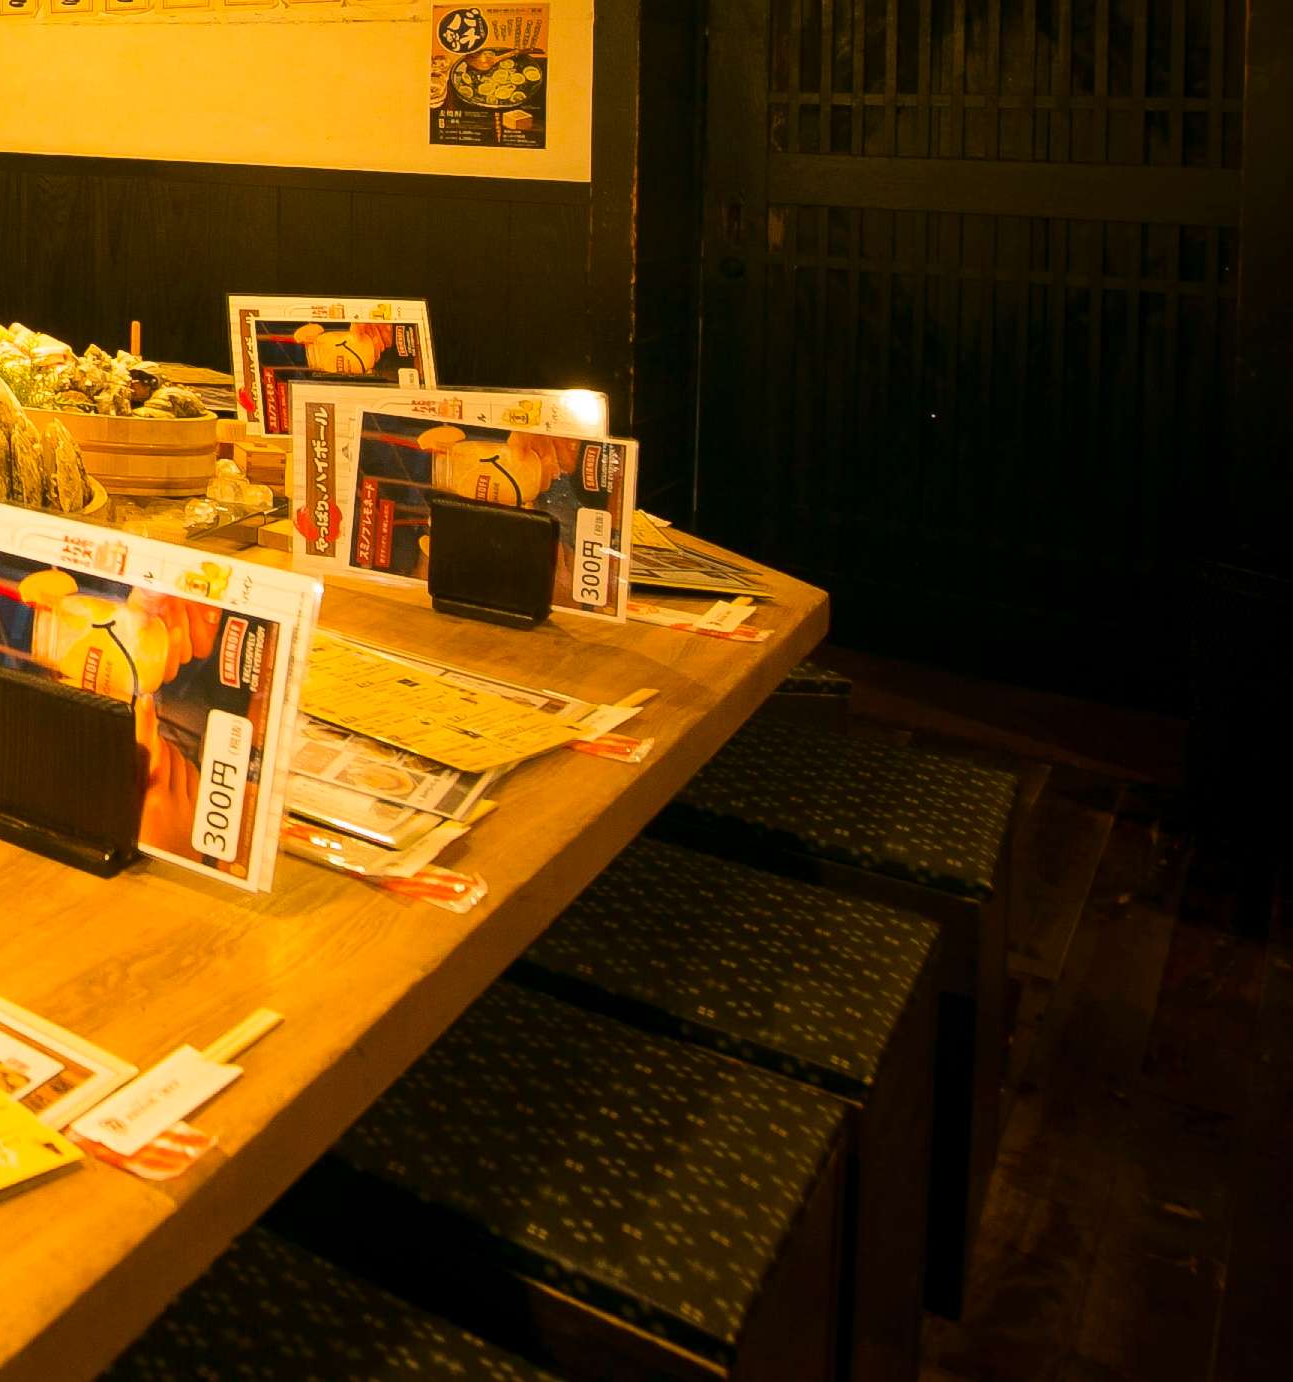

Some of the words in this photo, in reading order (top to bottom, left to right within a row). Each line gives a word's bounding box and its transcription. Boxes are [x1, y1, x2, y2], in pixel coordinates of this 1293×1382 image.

[315, 406, 330, 553] やっぱり、ハイボール
[580, 539, 603, 601] 300円
[222, 620, 245, 685] SMIRNOFF
[202, 760, 238, 852] 300円
